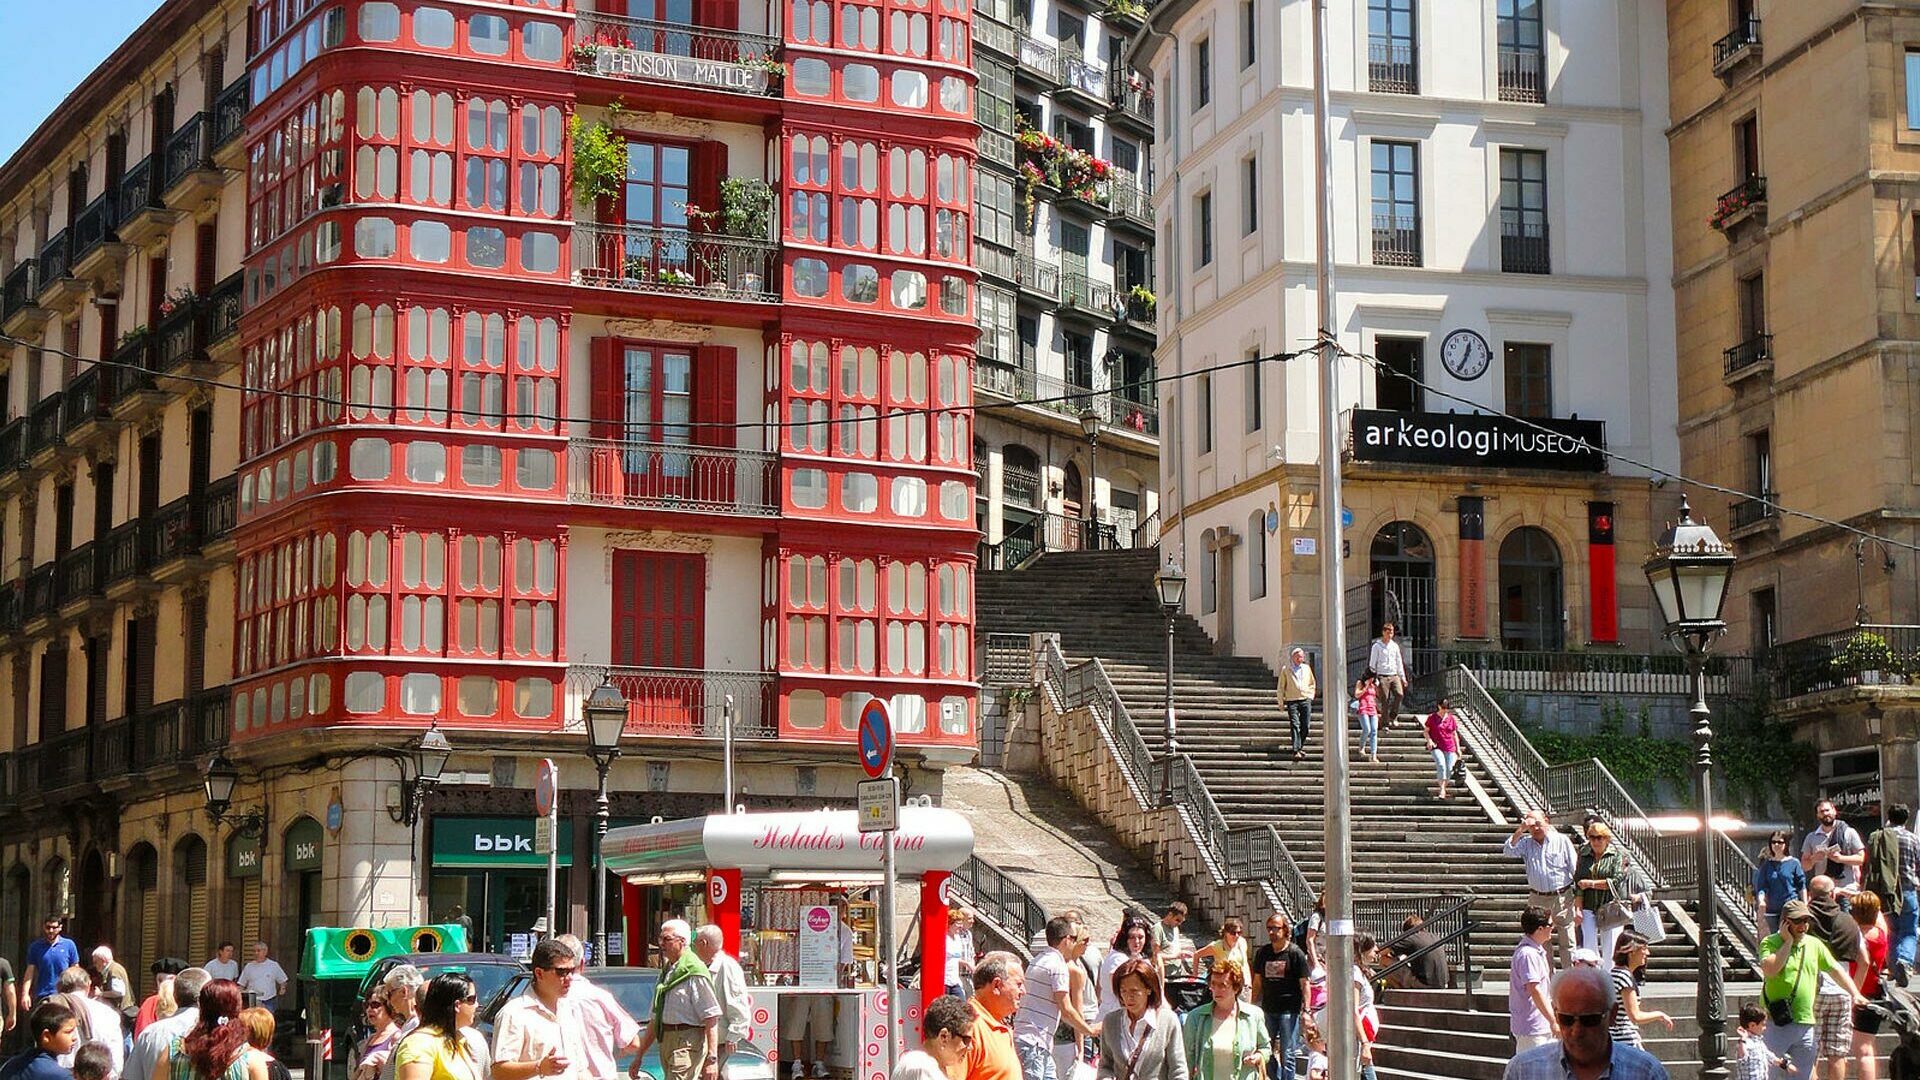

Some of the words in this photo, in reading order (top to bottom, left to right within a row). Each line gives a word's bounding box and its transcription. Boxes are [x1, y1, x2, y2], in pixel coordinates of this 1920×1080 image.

[611, 53, 678, 79] PENSION
[695, 63, 753, 89] MATILDE
[1365, 418, 1498, 456] arkeologi
[1503, 432, 1591, 455] MUSEOA
[475, 834, 532, 852] bbk
[753, 824, 845, 850] Helados
[239, 851, 256, 867] bbk
[297, 842, 315, 860] bbk
[712, 882, 723, 898] B
